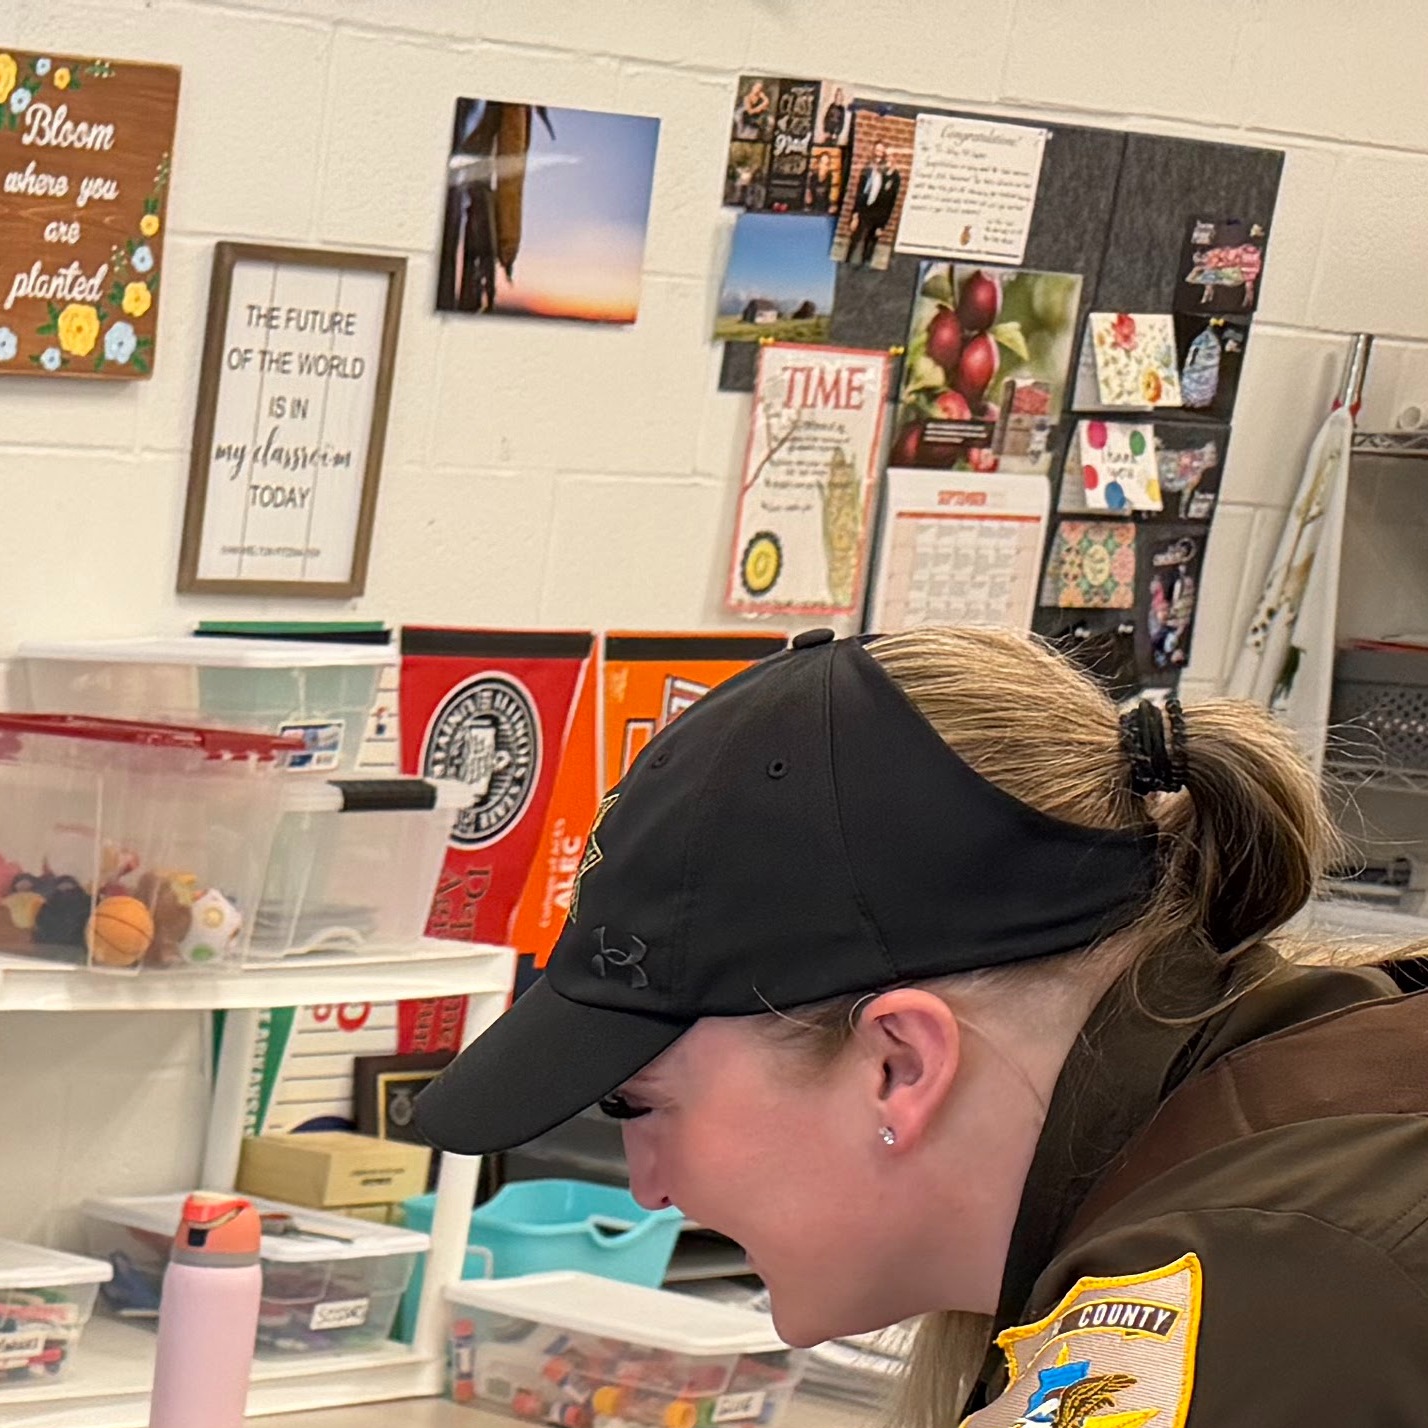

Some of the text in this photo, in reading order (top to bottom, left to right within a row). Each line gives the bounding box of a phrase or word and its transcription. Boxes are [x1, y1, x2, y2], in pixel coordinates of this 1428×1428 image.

[21, 103, 115, 151] Bloom
[3, 161, 119, 206] where you
[44, 219, 80, 245] are
[3, 261, 108, 310] planted
[245, 304, 358, 337] THE FUTURE
[227, 347, 365, 381] OF THE WORLD
[781, 366, 868, 411] TIME
[267, 395, 310, 420] IS IN
[214, 425, 353, 480] my classroom
[249, 485, 311, 509] TODAY
[1077, 1303, 1172, 1332] COUNTY
